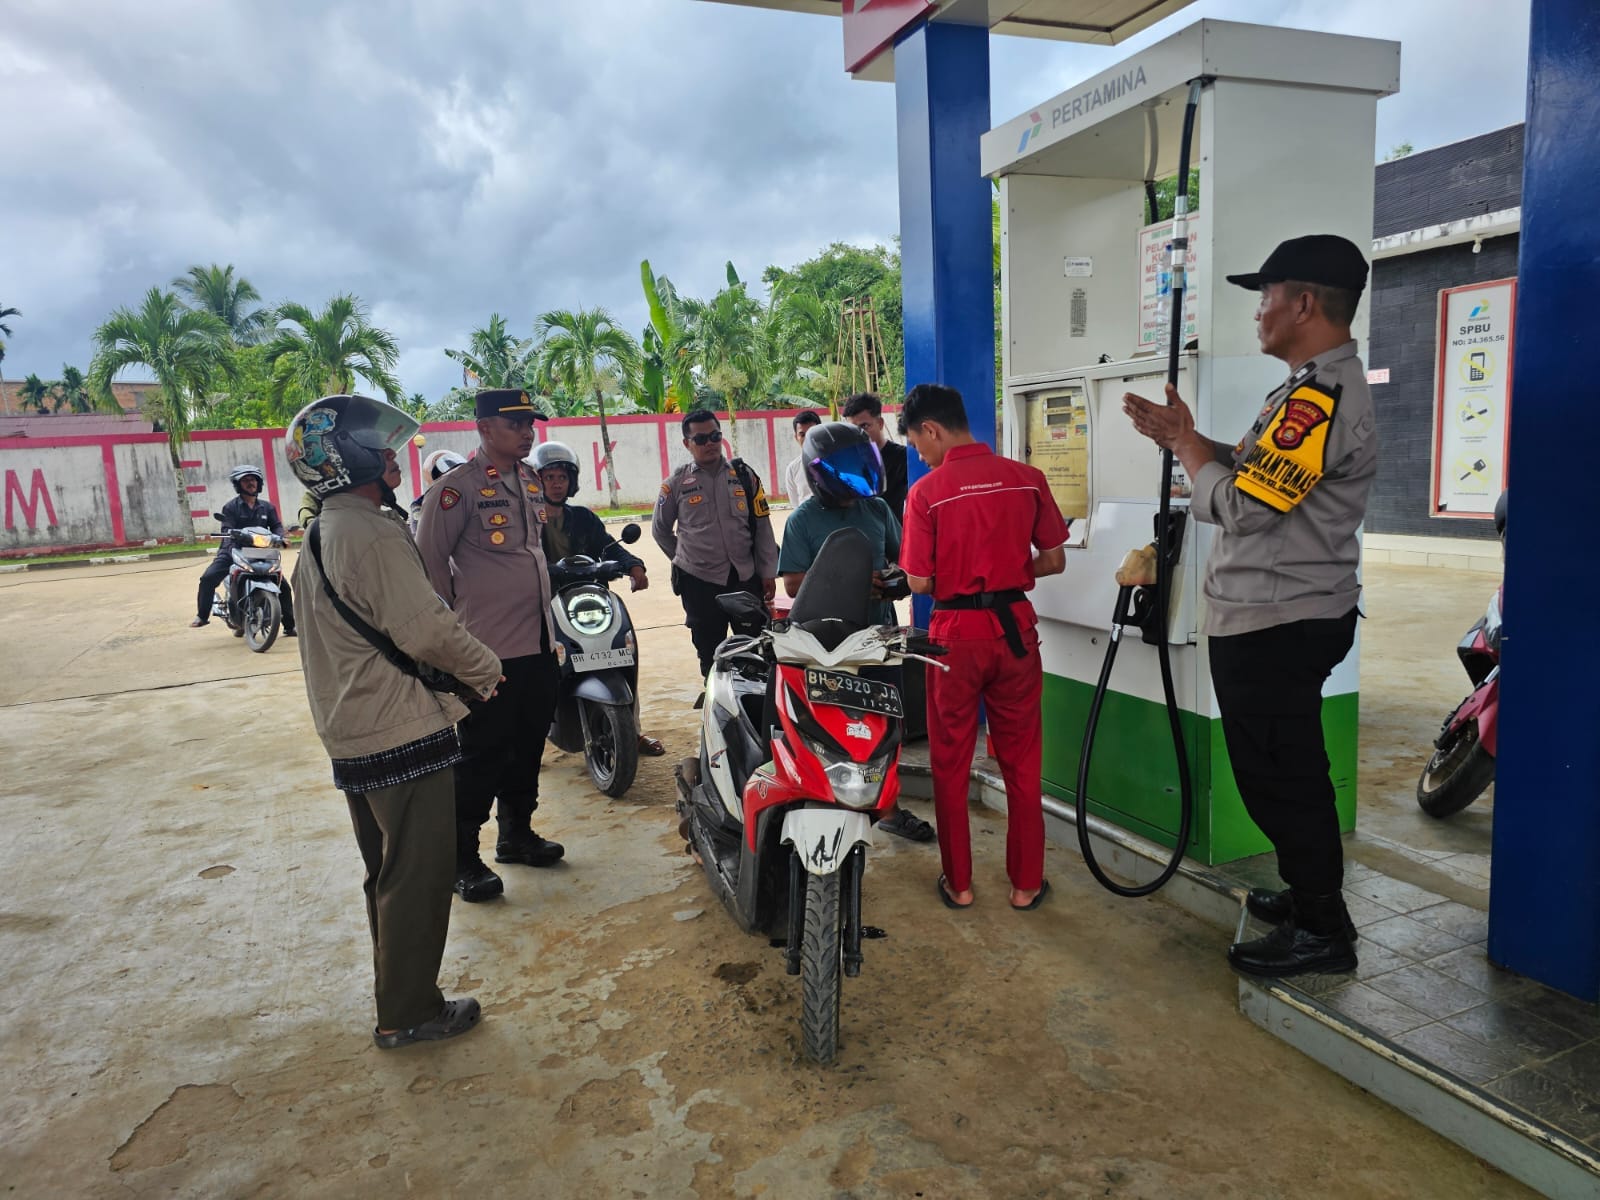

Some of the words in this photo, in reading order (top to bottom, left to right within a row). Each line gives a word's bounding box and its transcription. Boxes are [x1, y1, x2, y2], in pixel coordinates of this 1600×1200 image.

[1052, 65, 1147, 129] PERTAMINA
[1459, 323, 1491, 336] SPBU
[572, 655, 585, 663] BH
[590, 650, 613, 661] 4732
[808, 671, 827, 685] BH
[836, 676, 872, 694] 2920
[862, 698, 899, 713] 11-24
